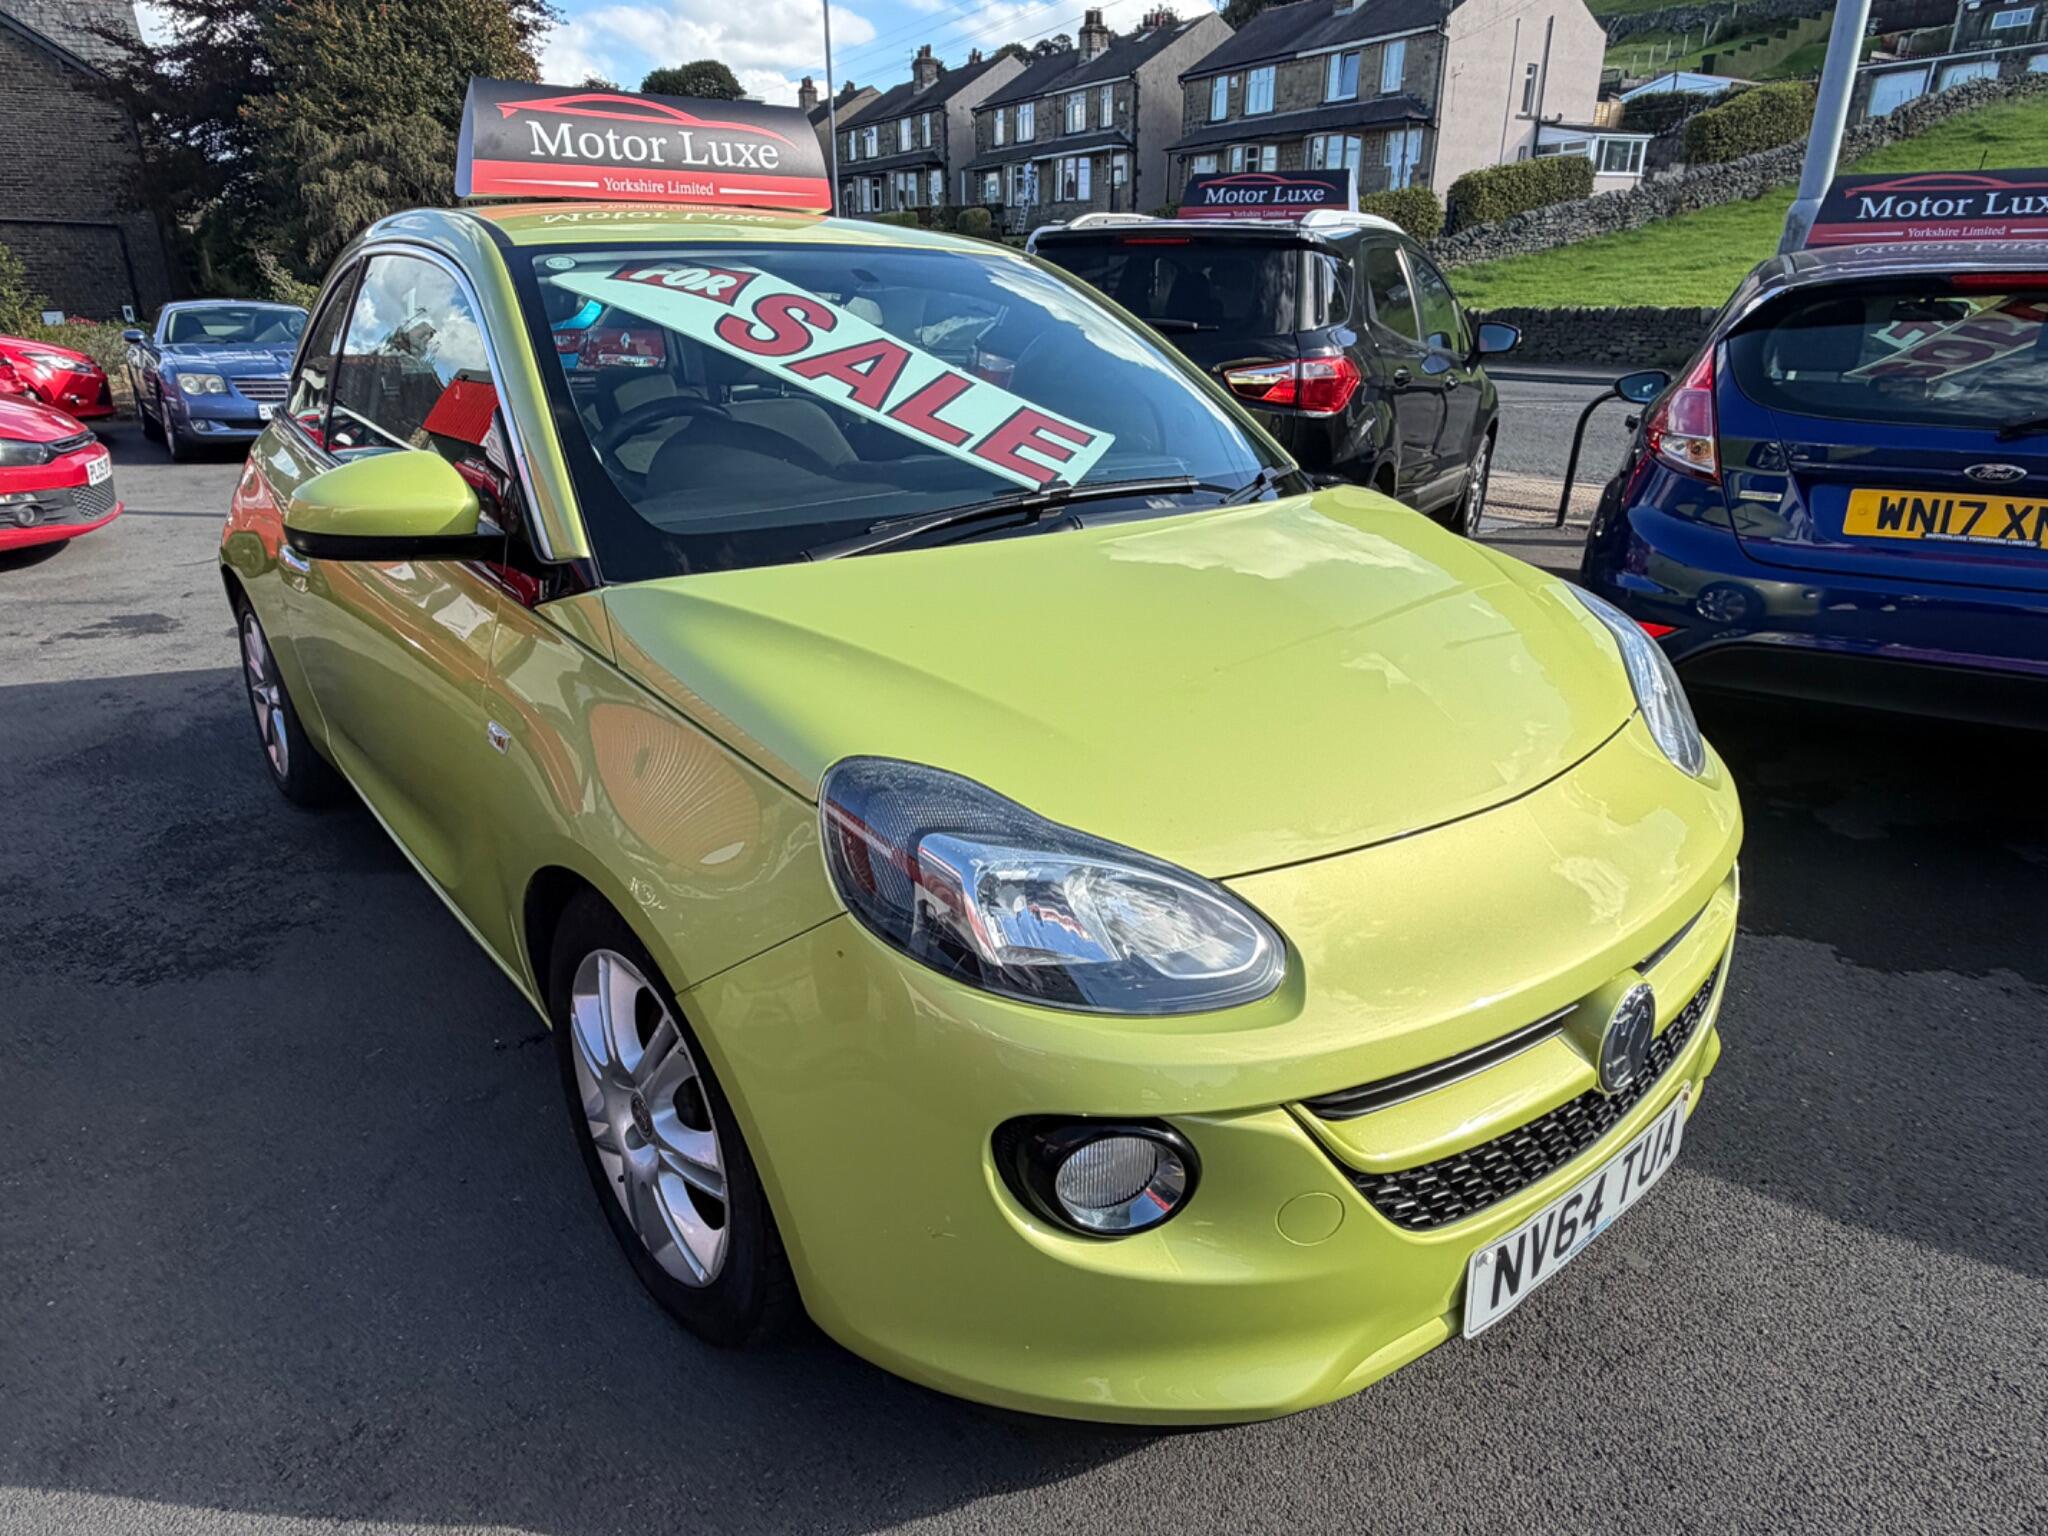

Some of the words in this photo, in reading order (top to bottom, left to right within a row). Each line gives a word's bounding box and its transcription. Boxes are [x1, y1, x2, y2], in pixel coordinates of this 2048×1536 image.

[525, 120, 668, 163] Motor
[679, 131, 780, 170] Luxe
[603, 177, 665, 194] Yorkshire
[667, 180, 714, 196] Limited
[1203, 187, 1268, 204] Motor
[1272, 186, 1325, 203] Luxe
[1856, 195, 1973, 219] Motor
[1907, 227, 1959, 238] Yorkshire
[1961, 226, 2006, 236] Limited
[629, 267, 738, 296] FOR
[713, 292, 1097, 485] SALE
[1976, 467, 2015, 480] Ford
[1876, 496, 1988, 536] WN17
[1490, 1172, 1607, 1310] NV64
[1619, 1109, 1678, 1205] TUA
